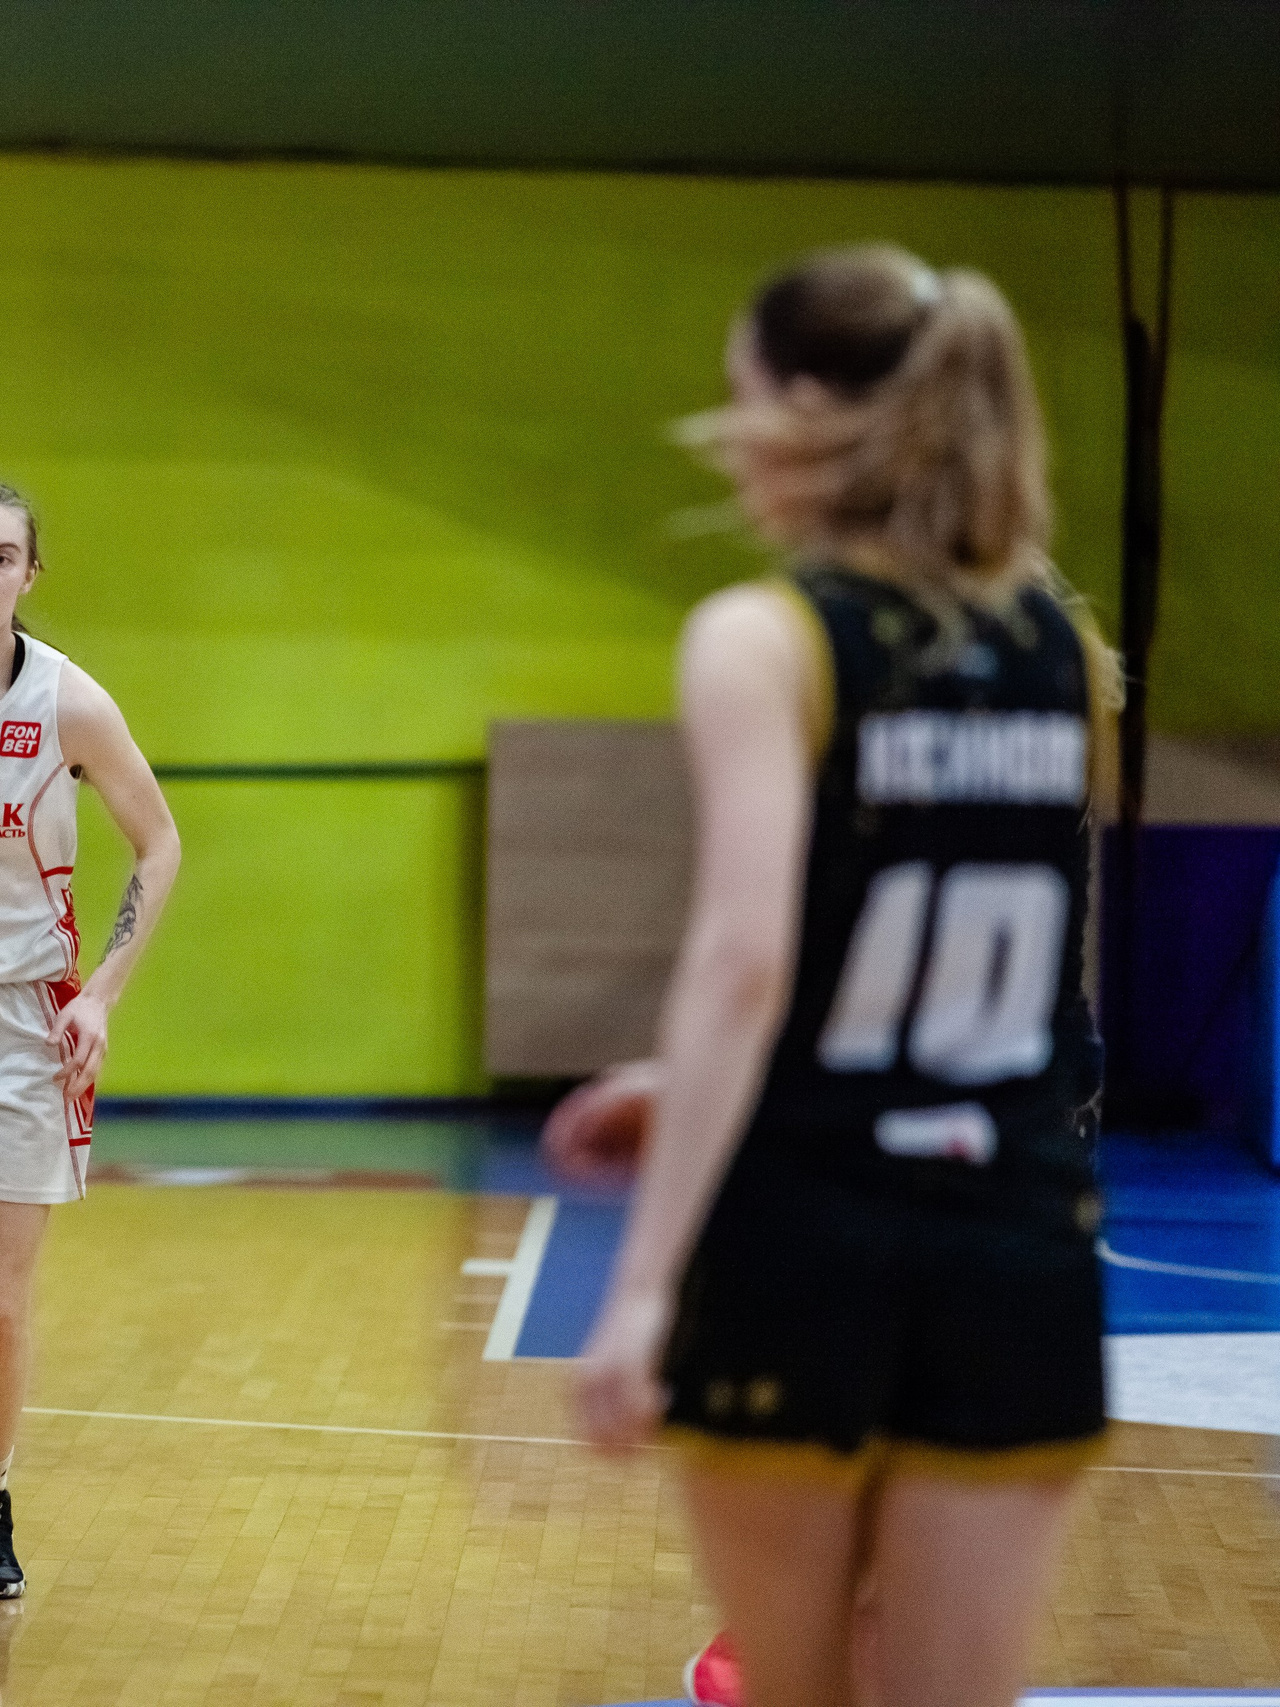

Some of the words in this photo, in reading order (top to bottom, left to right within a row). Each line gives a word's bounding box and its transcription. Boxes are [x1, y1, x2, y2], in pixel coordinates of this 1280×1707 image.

[3, 724, 40, 739] FON
[2, 740, 37, 754] BET
[817, 858, 1071, 1087] 10
